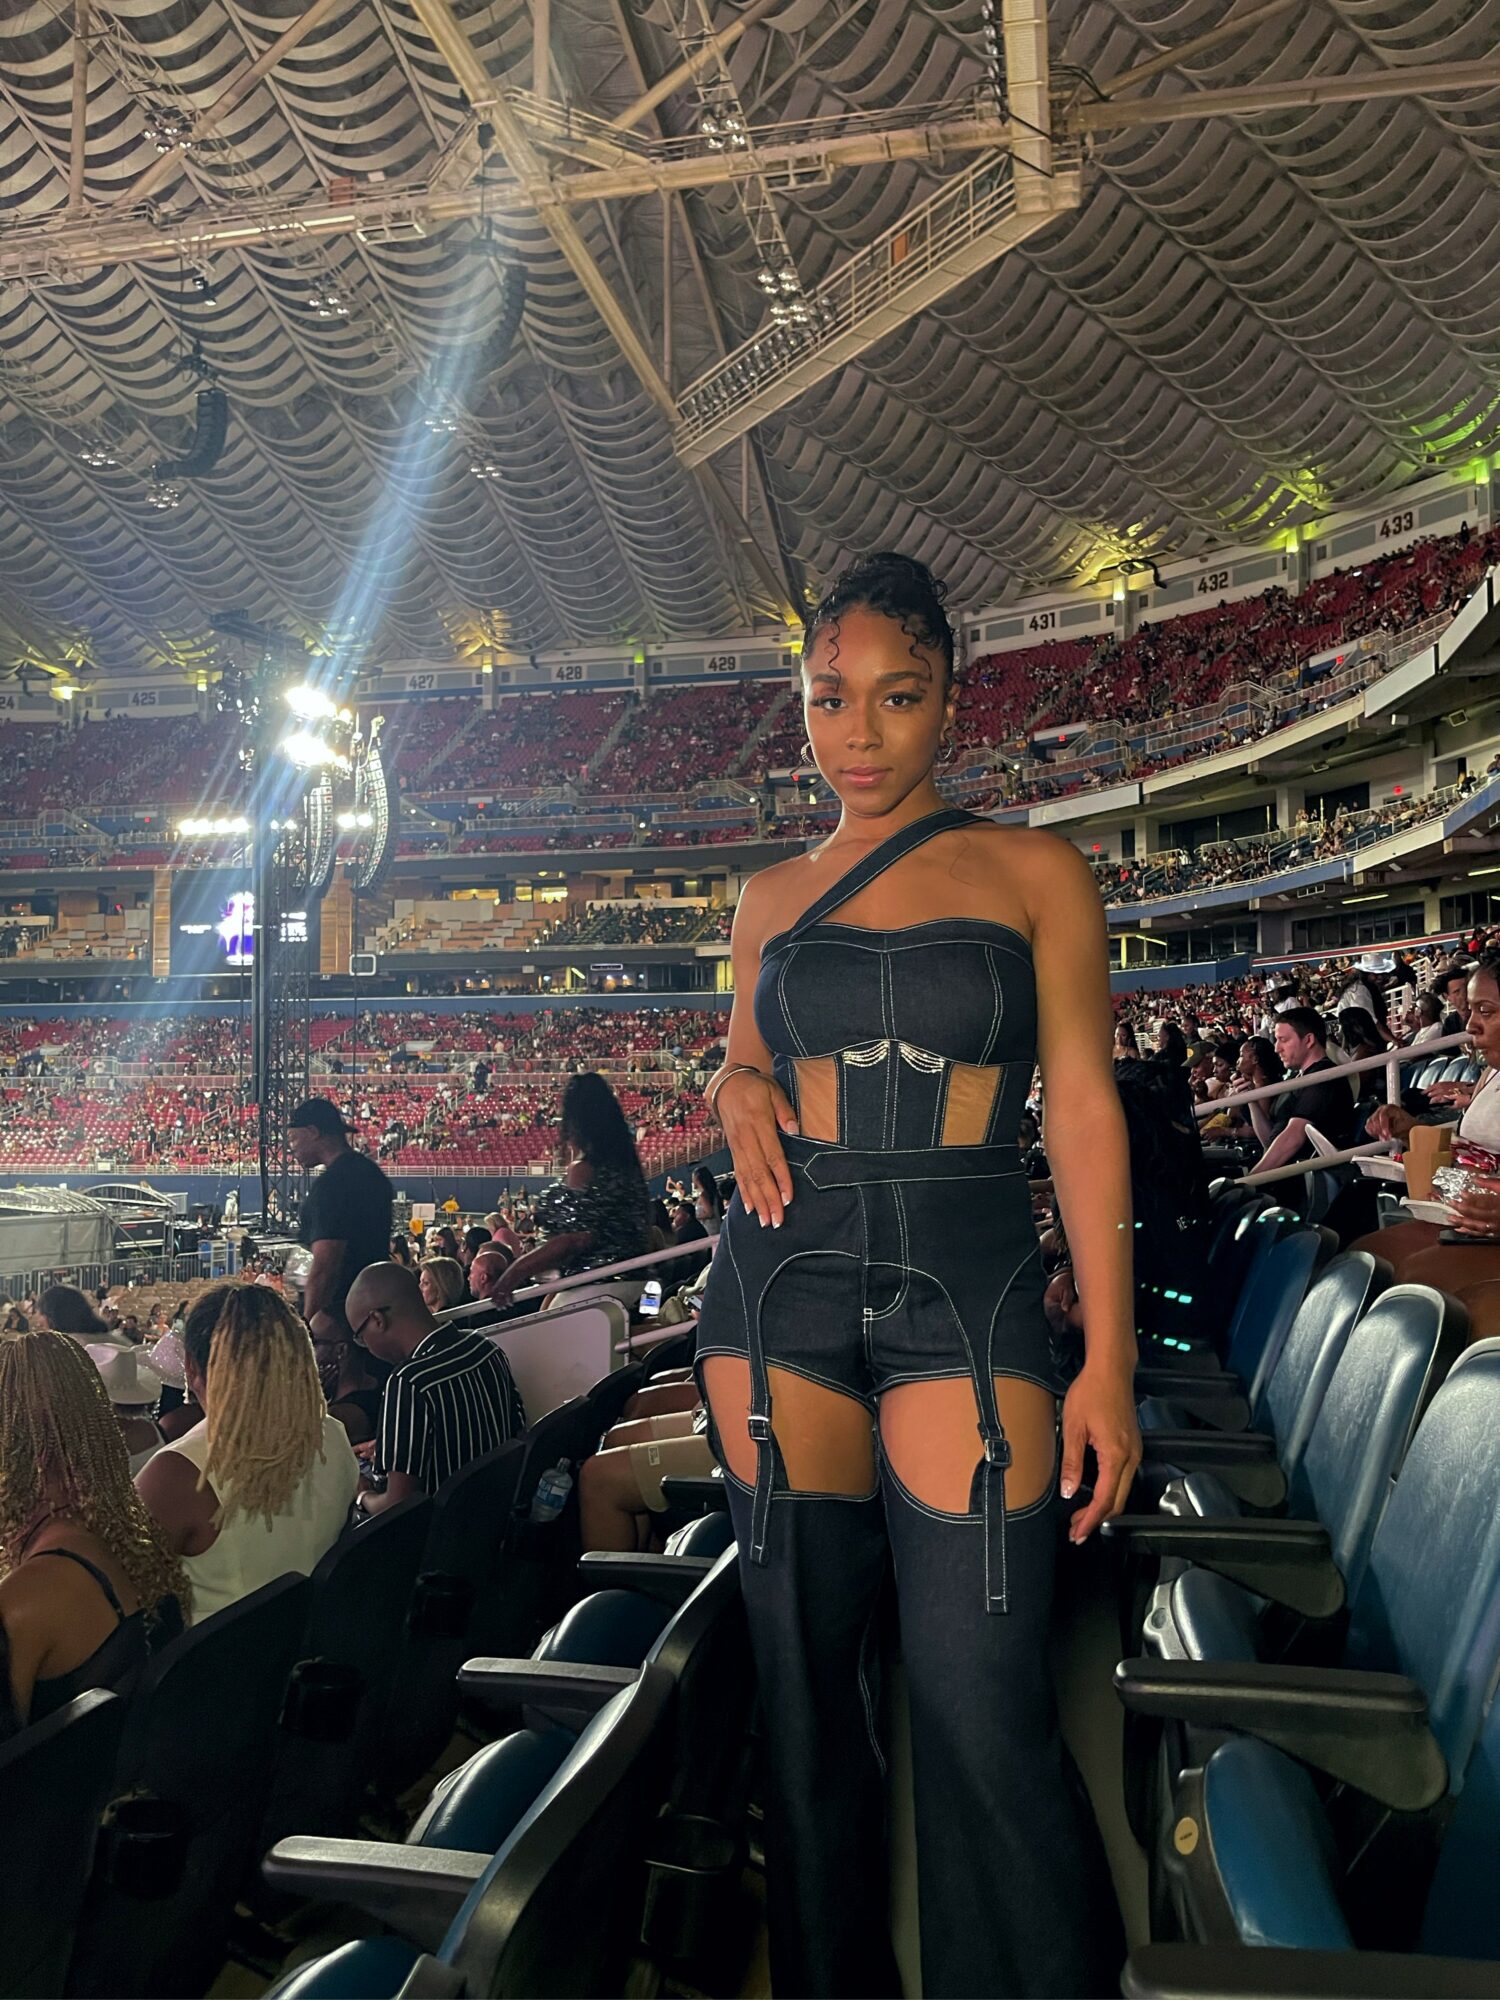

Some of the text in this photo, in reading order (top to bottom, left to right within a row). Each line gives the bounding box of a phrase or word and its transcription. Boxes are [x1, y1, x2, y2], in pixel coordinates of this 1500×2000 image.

[1380, 511, 1413, 538] 433
[1198, 571, 1230, 594] 432
[1029, 612, 1056, 632] 431
[708, 656, 736, 672] 429
[556, 665, 583, 681] 428
[408, 674, 434, 690] 427
[132, 692, 157, 706] 425
